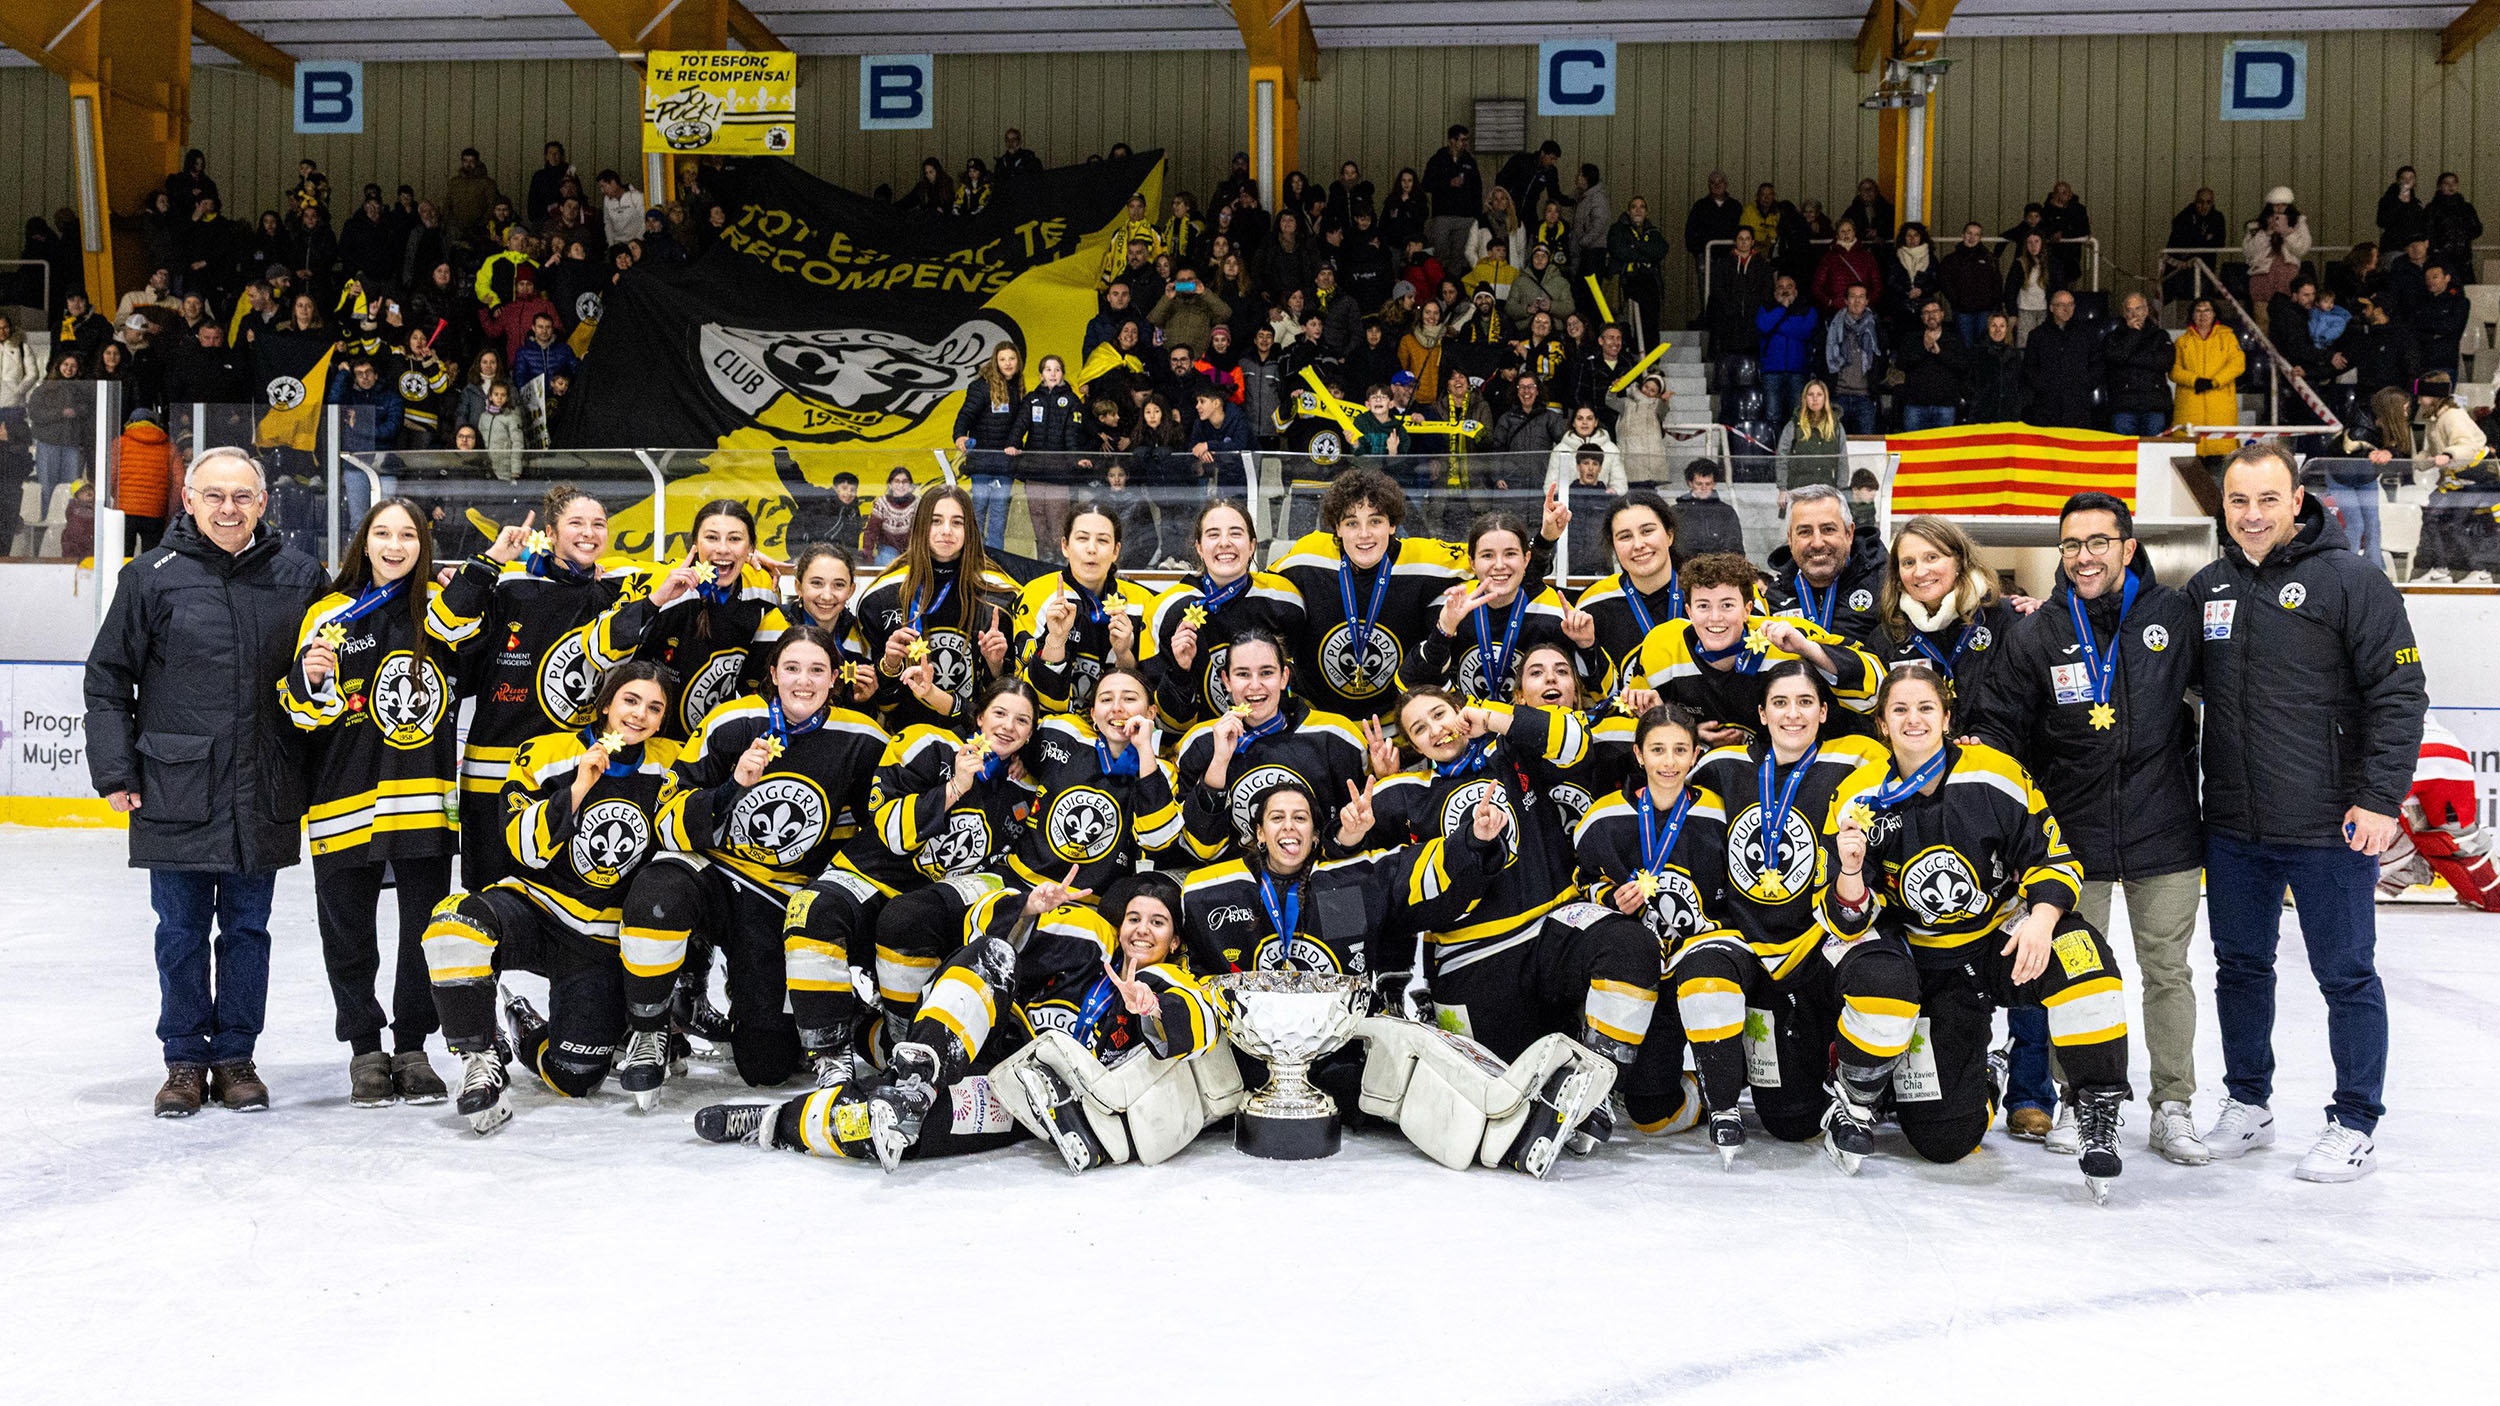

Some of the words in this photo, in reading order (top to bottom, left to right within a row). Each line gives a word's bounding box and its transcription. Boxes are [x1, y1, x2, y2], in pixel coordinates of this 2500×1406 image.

[681, 55, 706, 67] TOT
[712, 55, 769, 70] ESFORÇ
[656, 68, 673, 81] TÉ
[678, 70, 790, 82] RECOMPENSA!
[1549, 50, 1605, 104] C
[2233, 51, 2295, 108] D
[303, 71, 353, 123] B
[680, 84, 706, 105] JO
[870, 65, 923, 119] B
[656, 102, 722, 123] PUCK!
[738, 204, 812, 243] TOT
[1014, 217, 1067, 257] TÉ
[714, 350, 765, 395] CLUB
[1328, 667, 1343, 683] CLUB
[550, 694, 569, 713] CLUB
[23, 743, 83, 771] Mujer
[1052, 825, 1064, 842] CLUB
[1733, 812, 1812, 852] PUIGRDÀ
[788, 845, 804, 858] GEL
[1093, 841, 1106, 851] GEL
[575, 850, 590, 869] CLUB
[1732, 862, 1750, 883] CLUB
[1792, 868, 1807, 884] GEL
[1903, 1079, 1923, 1090] Chia
[1913, 1071, 1936, 1080] Xavier
